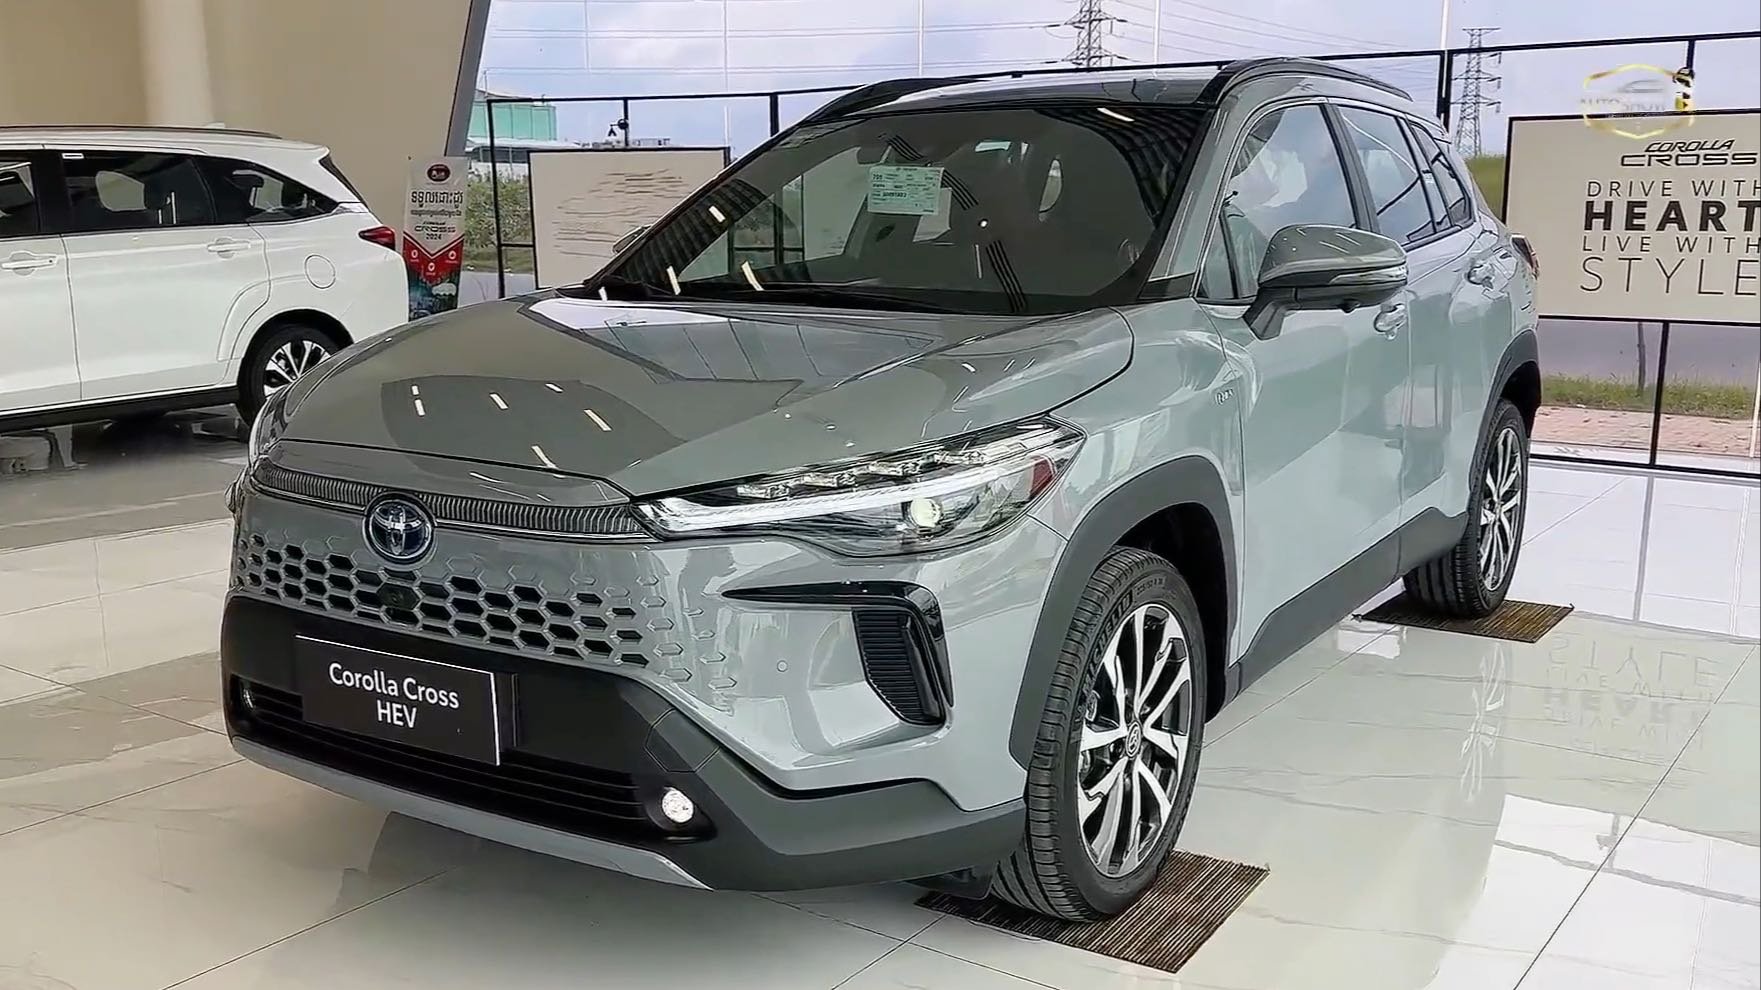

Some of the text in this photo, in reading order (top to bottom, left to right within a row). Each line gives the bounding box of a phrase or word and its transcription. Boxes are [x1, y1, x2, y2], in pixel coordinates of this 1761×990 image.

[1645, 139, 1735, 152] COROLLA
[1621, 153, 1758, 167] CROSS
[1587, 179, 1760, 197] DRIVE WITH
[1583, 200, 1760, 232] HEART
[1582, 235, 1760, 253] LIVE WITH
[1580, 256, 1759, 296] STYLE
[328, 661, 460, 710] Corolla Cross
[376, 699, 417, 729] HEV
